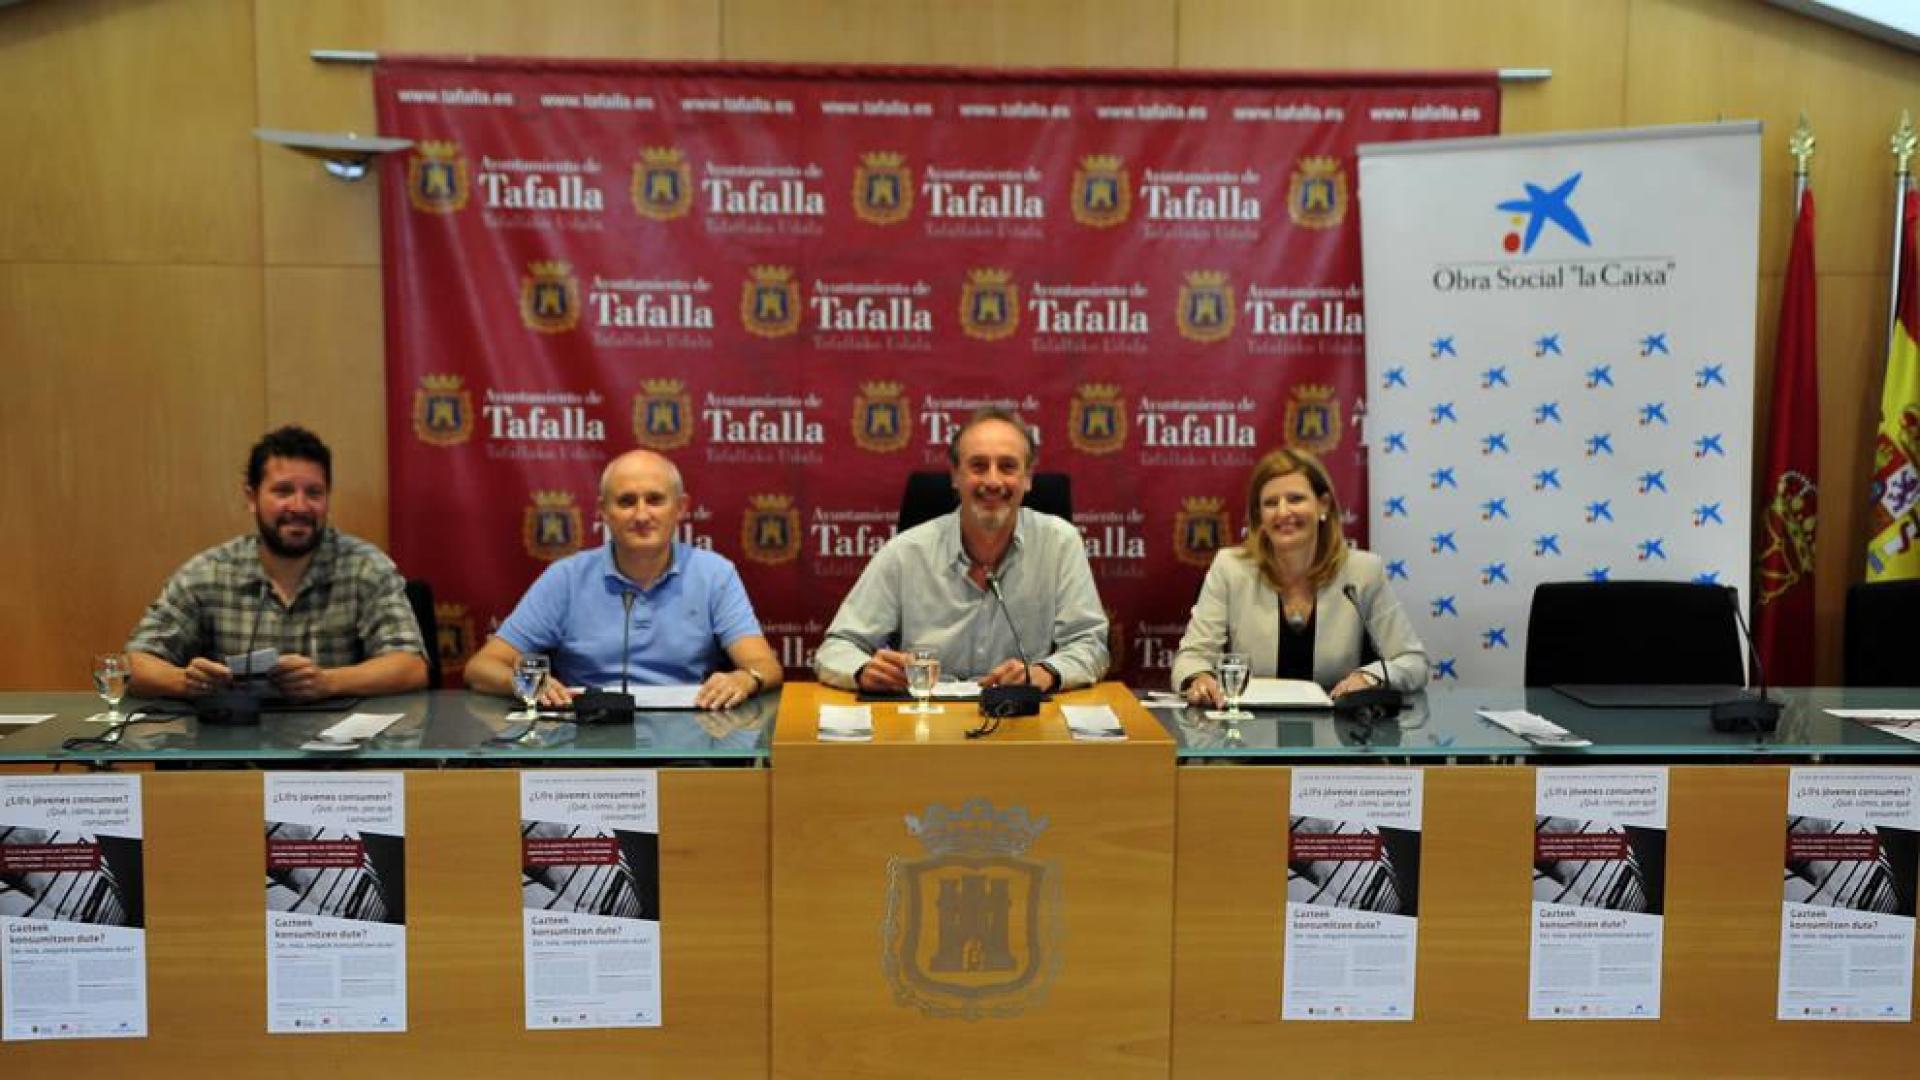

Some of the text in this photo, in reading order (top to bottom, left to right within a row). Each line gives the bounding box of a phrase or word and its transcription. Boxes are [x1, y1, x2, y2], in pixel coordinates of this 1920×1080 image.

[478, 174, 604, 211] Tafalla
[702, 179, 824, 215] Tafalla
[922, 184, 1044, 218] Tafalla
[1139, 185, 1261, 220] Tafalla
[1432, 267, 1491, 293] Obra
[1495, 264, 1564, 290] Social
[590, 292, 713, 328] Tafalla
[810, 296, 932, 331] Tafalla
[1028, 299, 1149, 333] Tafalla
[1245, 301, 1363, 334] Tafalla
[483, 405, 606, 441] Tafalla
[703, 408, 824, 444] Tafalla
[1137, 412, 1256, 447] Tafalla
